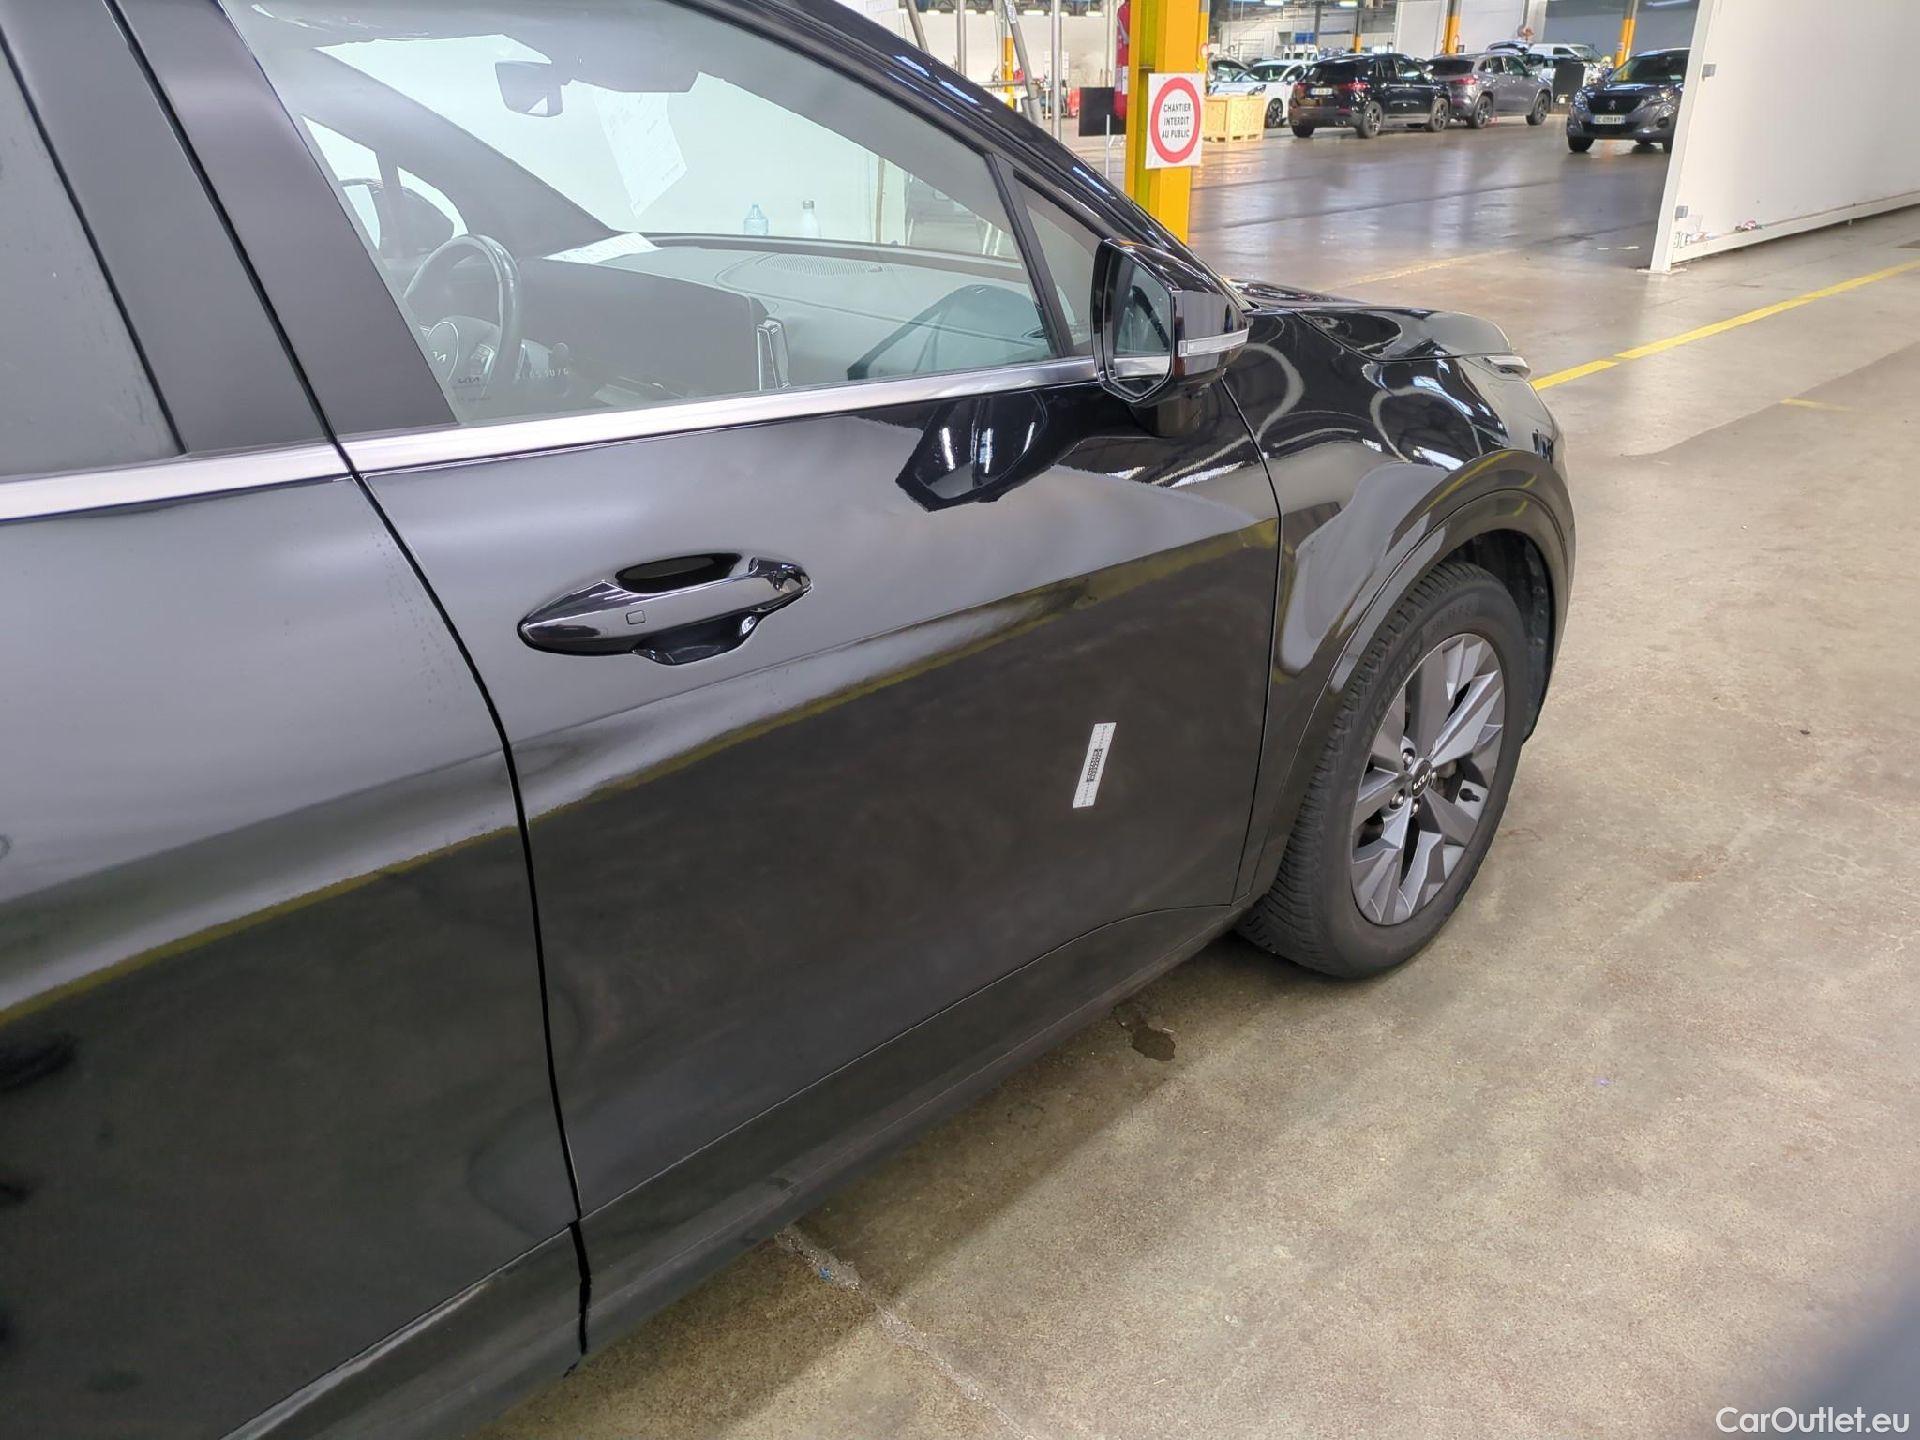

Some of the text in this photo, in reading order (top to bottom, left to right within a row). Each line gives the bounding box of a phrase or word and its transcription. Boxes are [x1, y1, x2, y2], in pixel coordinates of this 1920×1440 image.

[1163, 103, 1191, 112] CHANTIER
[1164, 116, 1190, 126] INTERDIT
[1162, 129, 1190, 138] AU PUBLIC
